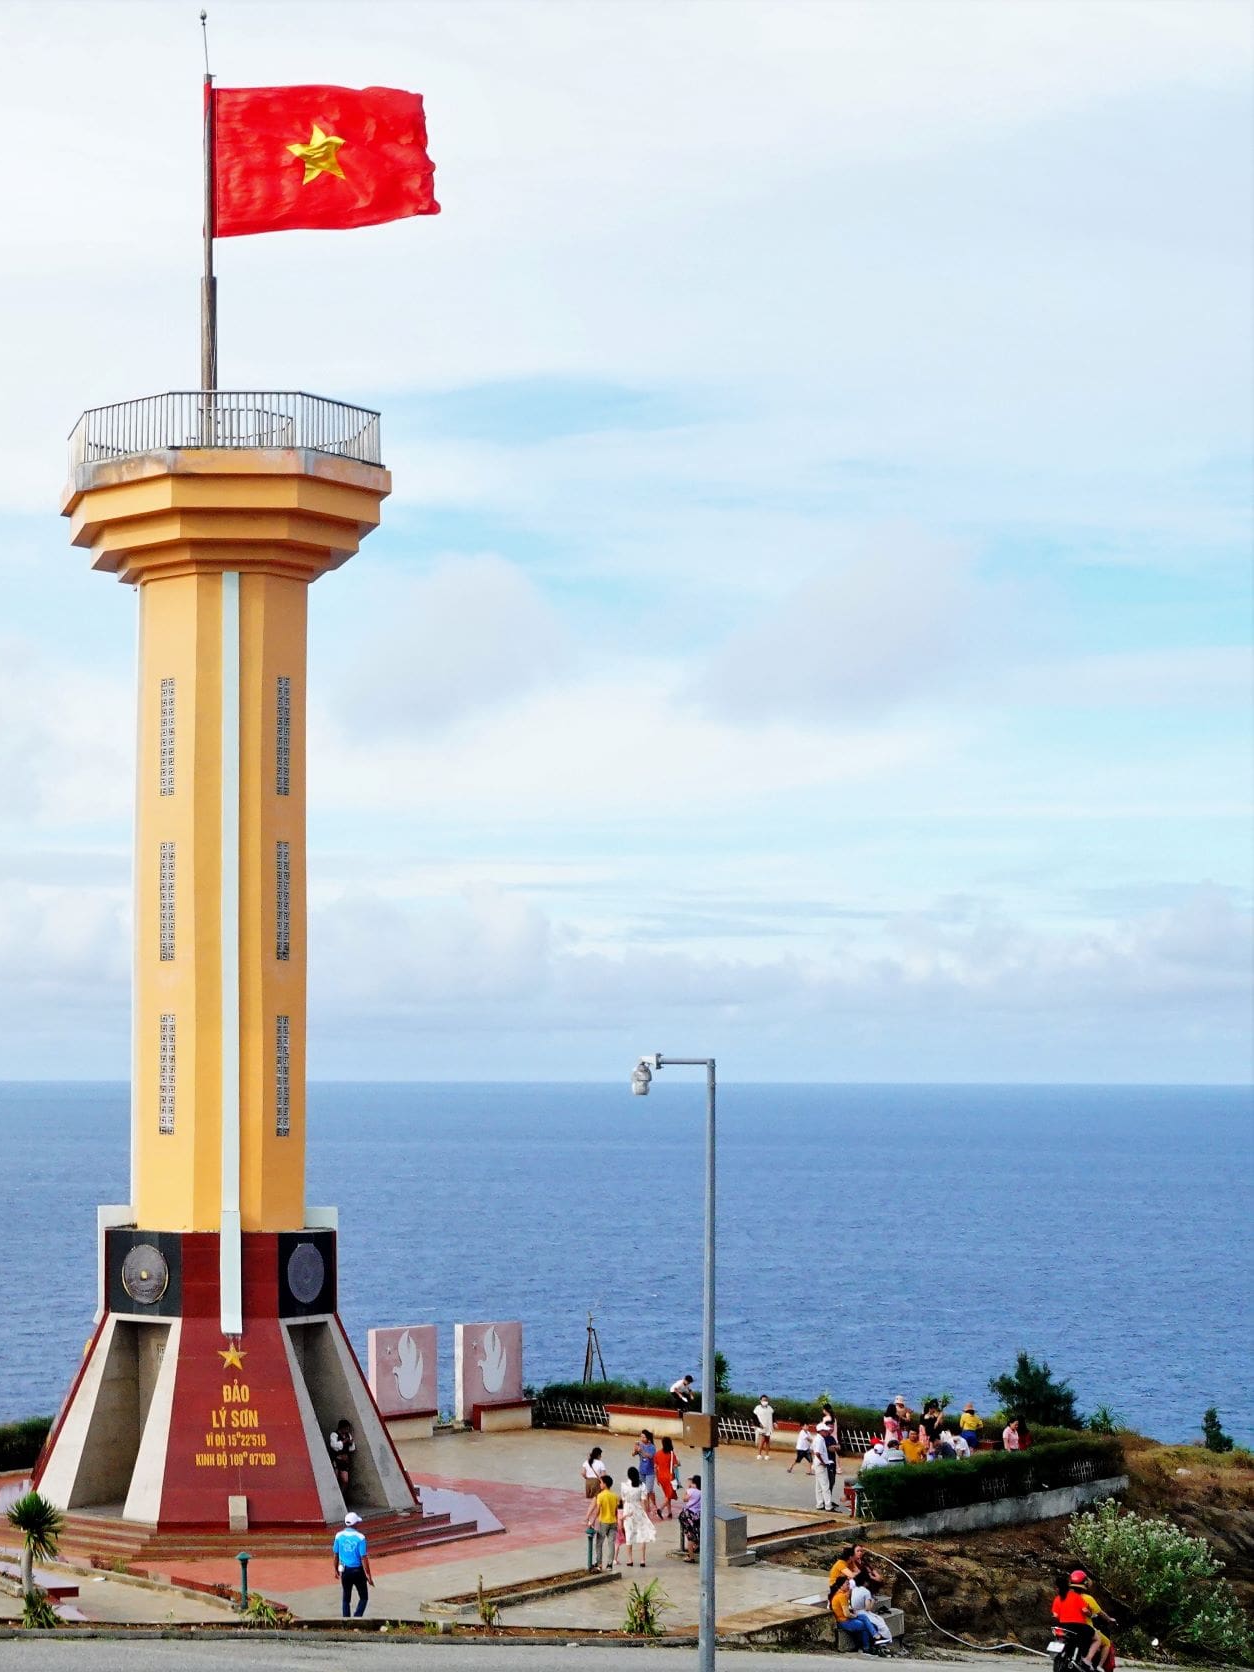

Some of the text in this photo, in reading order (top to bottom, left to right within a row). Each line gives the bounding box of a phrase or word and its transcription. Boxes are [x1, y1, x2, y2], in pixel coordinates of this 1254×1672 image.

[222, 1379, 250, 1403] ĐẢO
[212, 1406, 259, 1428] LÝ SƠN
[195, 1453, 215, 1466] KINH
